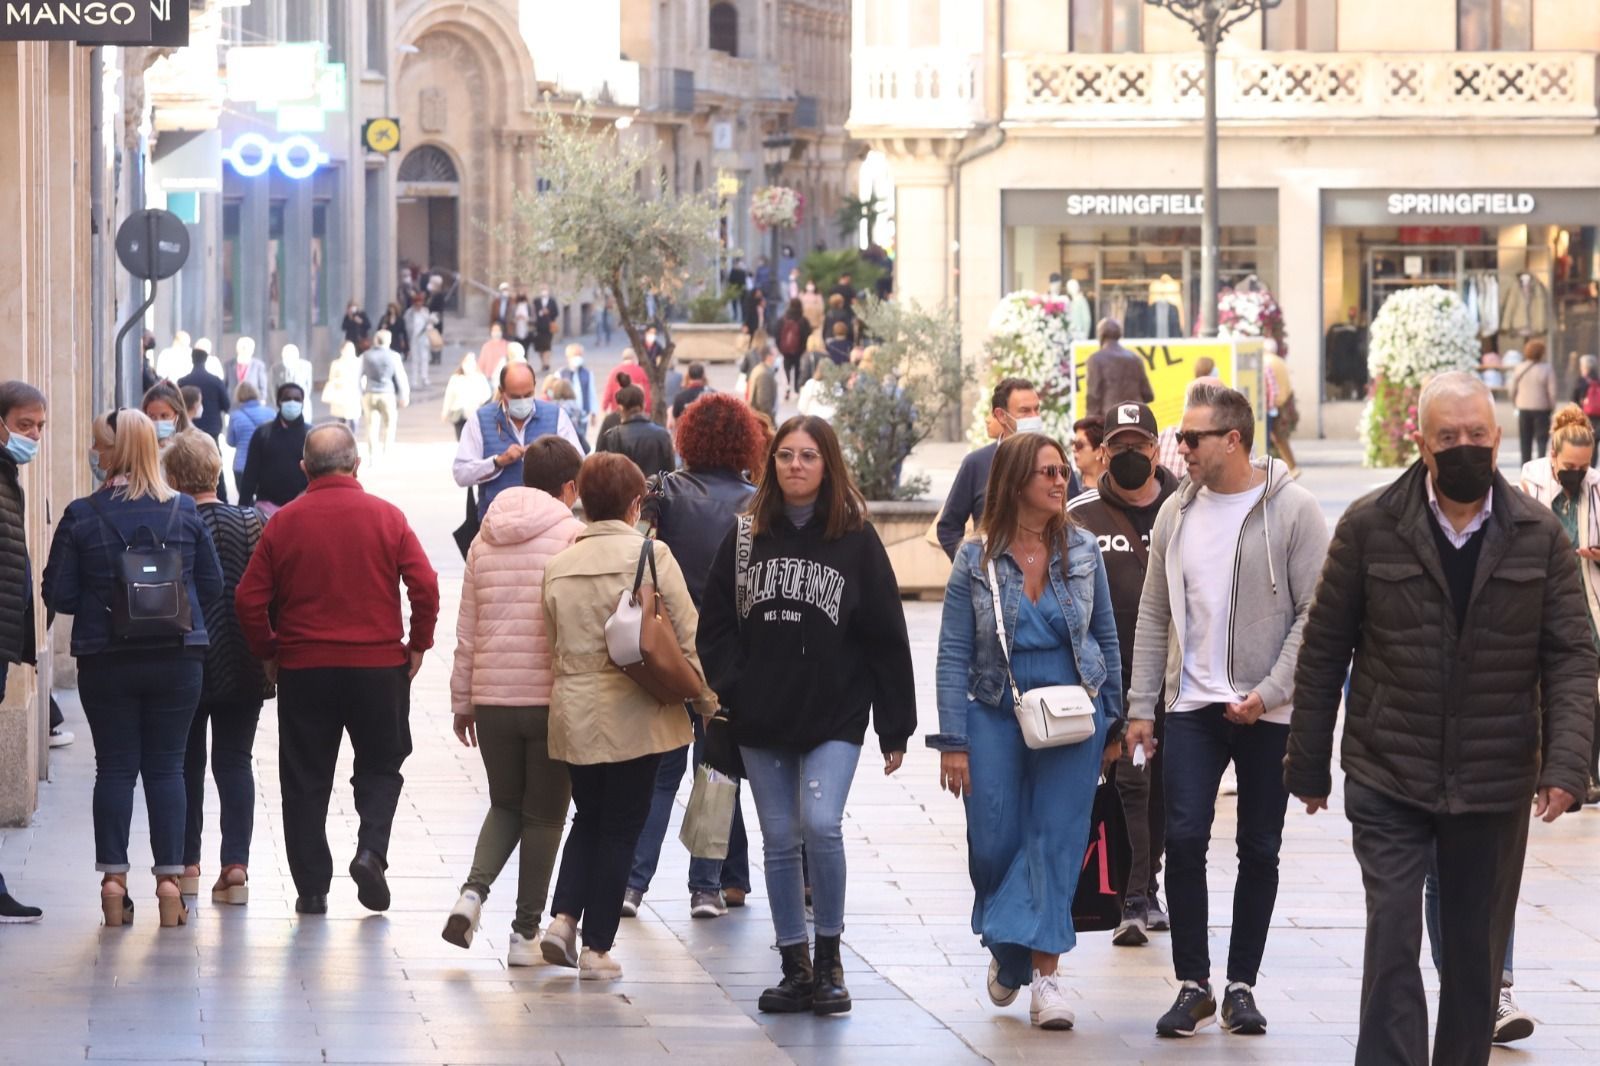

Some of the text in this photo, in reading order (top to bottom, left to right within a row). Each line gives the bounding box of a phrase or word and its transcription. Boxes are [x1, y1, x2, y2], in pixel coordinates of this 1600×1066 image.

[6, 2, 136, 25] MANGO
[1387, 192, 1536, 214] SPRINGFIELD
[781, 608, 802, 623] COAST
